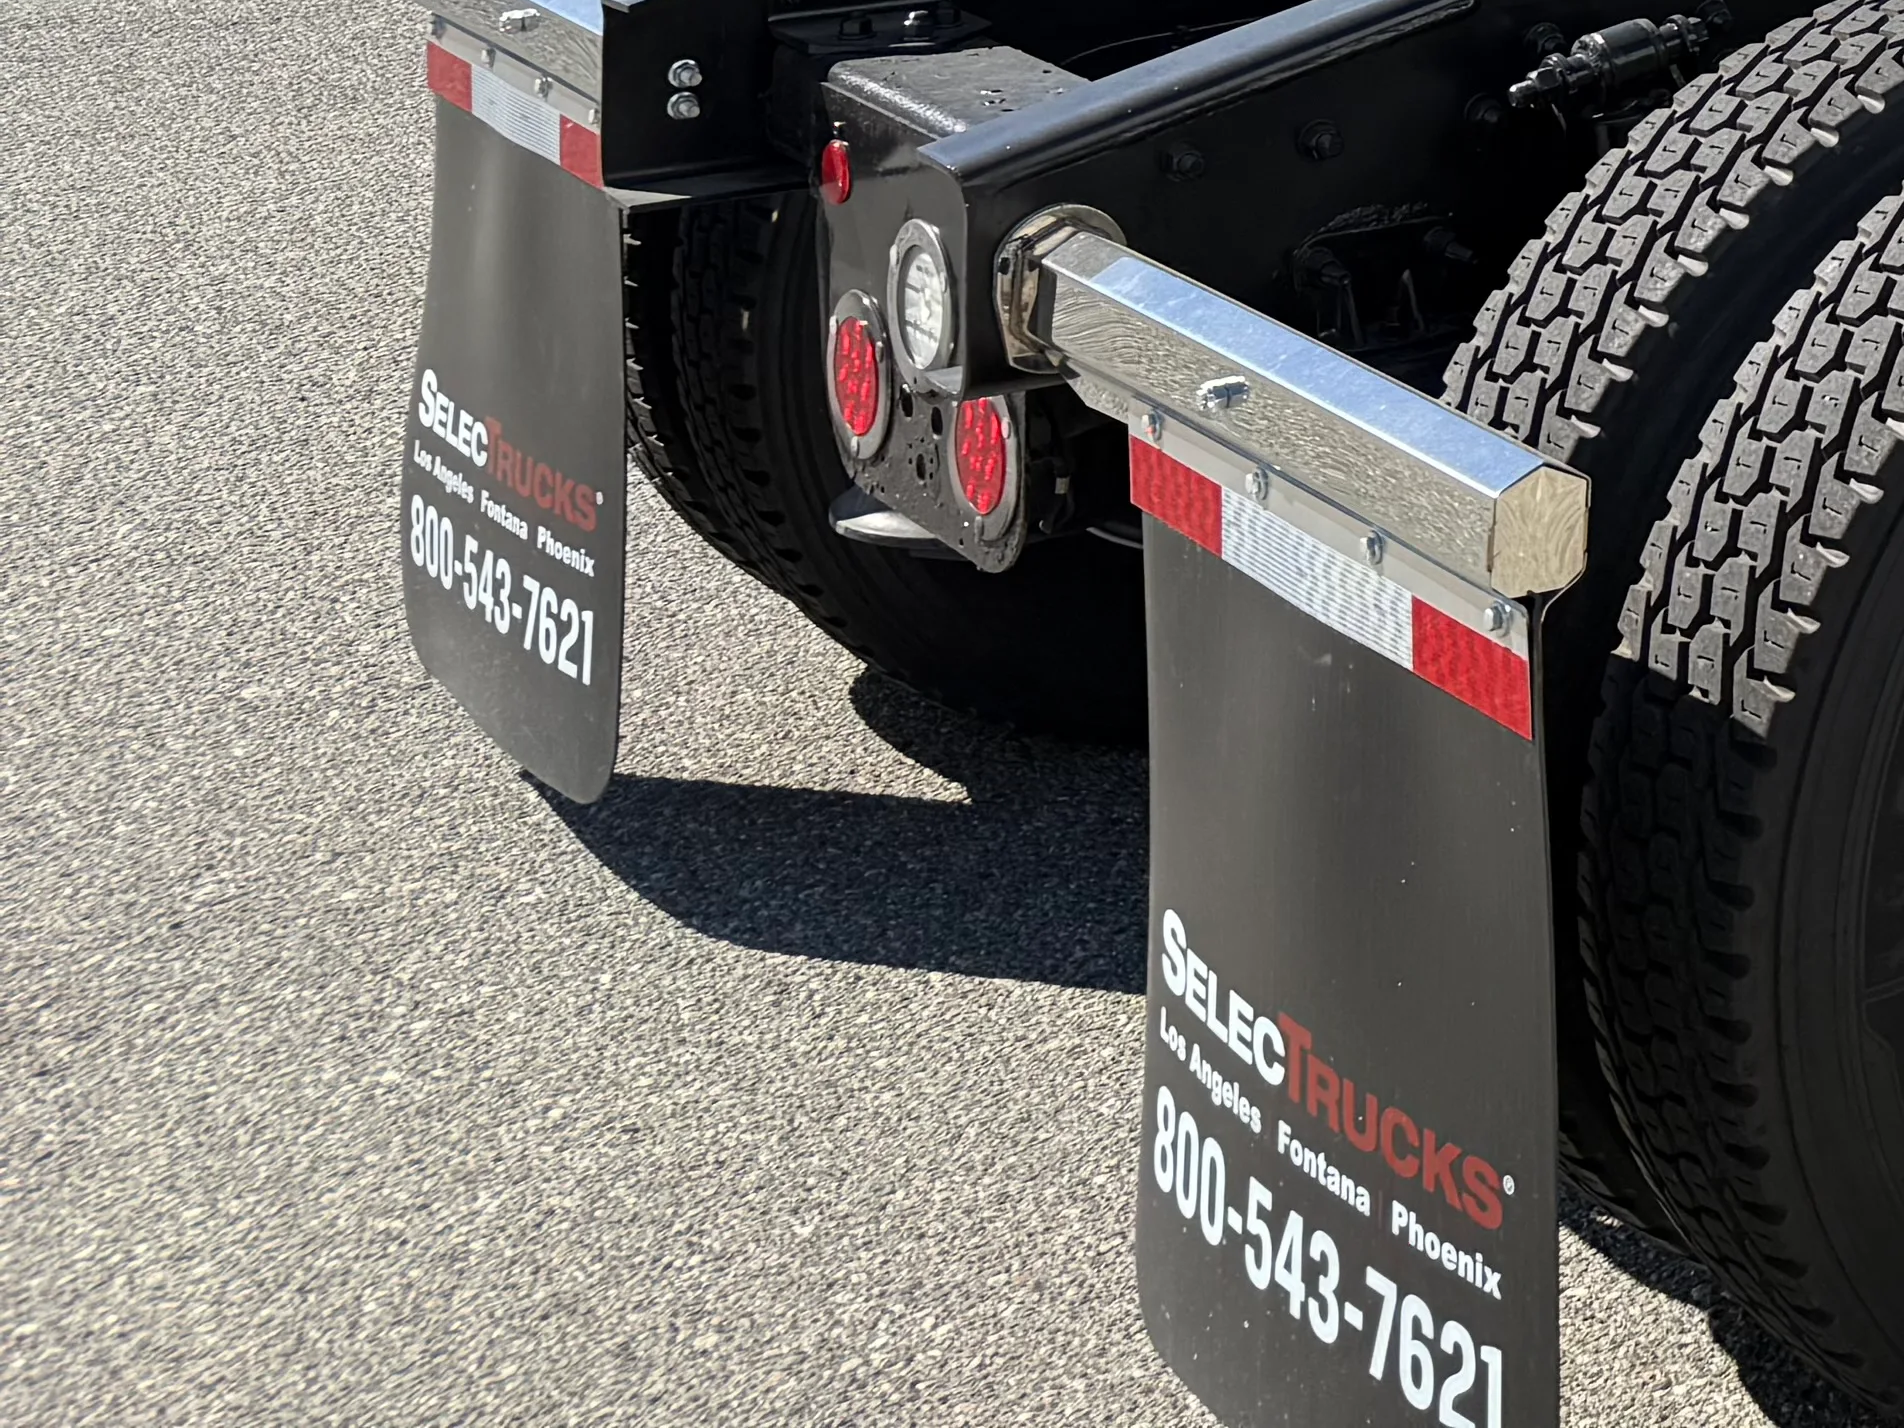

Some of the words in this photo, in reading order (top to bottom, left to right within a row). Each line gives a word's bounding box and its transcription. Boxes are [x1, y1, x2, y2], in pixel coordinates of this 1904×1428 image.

[410, 494, 595, 686] 800-543-7621
[413, 439, 433, 472] Los
[432, 455, 474, 504] Angeles
[480, 489, 528, 540] Fontana
[536, 525, 596, 577] Phoenix
[1153, 1086, 1503, 1428] 800-543-7621
[1160, 1006, 1187, 1061] Los
[1189, 1042, 1262, 1134] Angeles
[1277, 1118, 1371, 1217] Fontana
[1391, 1199, 1501, 1300] Phoenix
